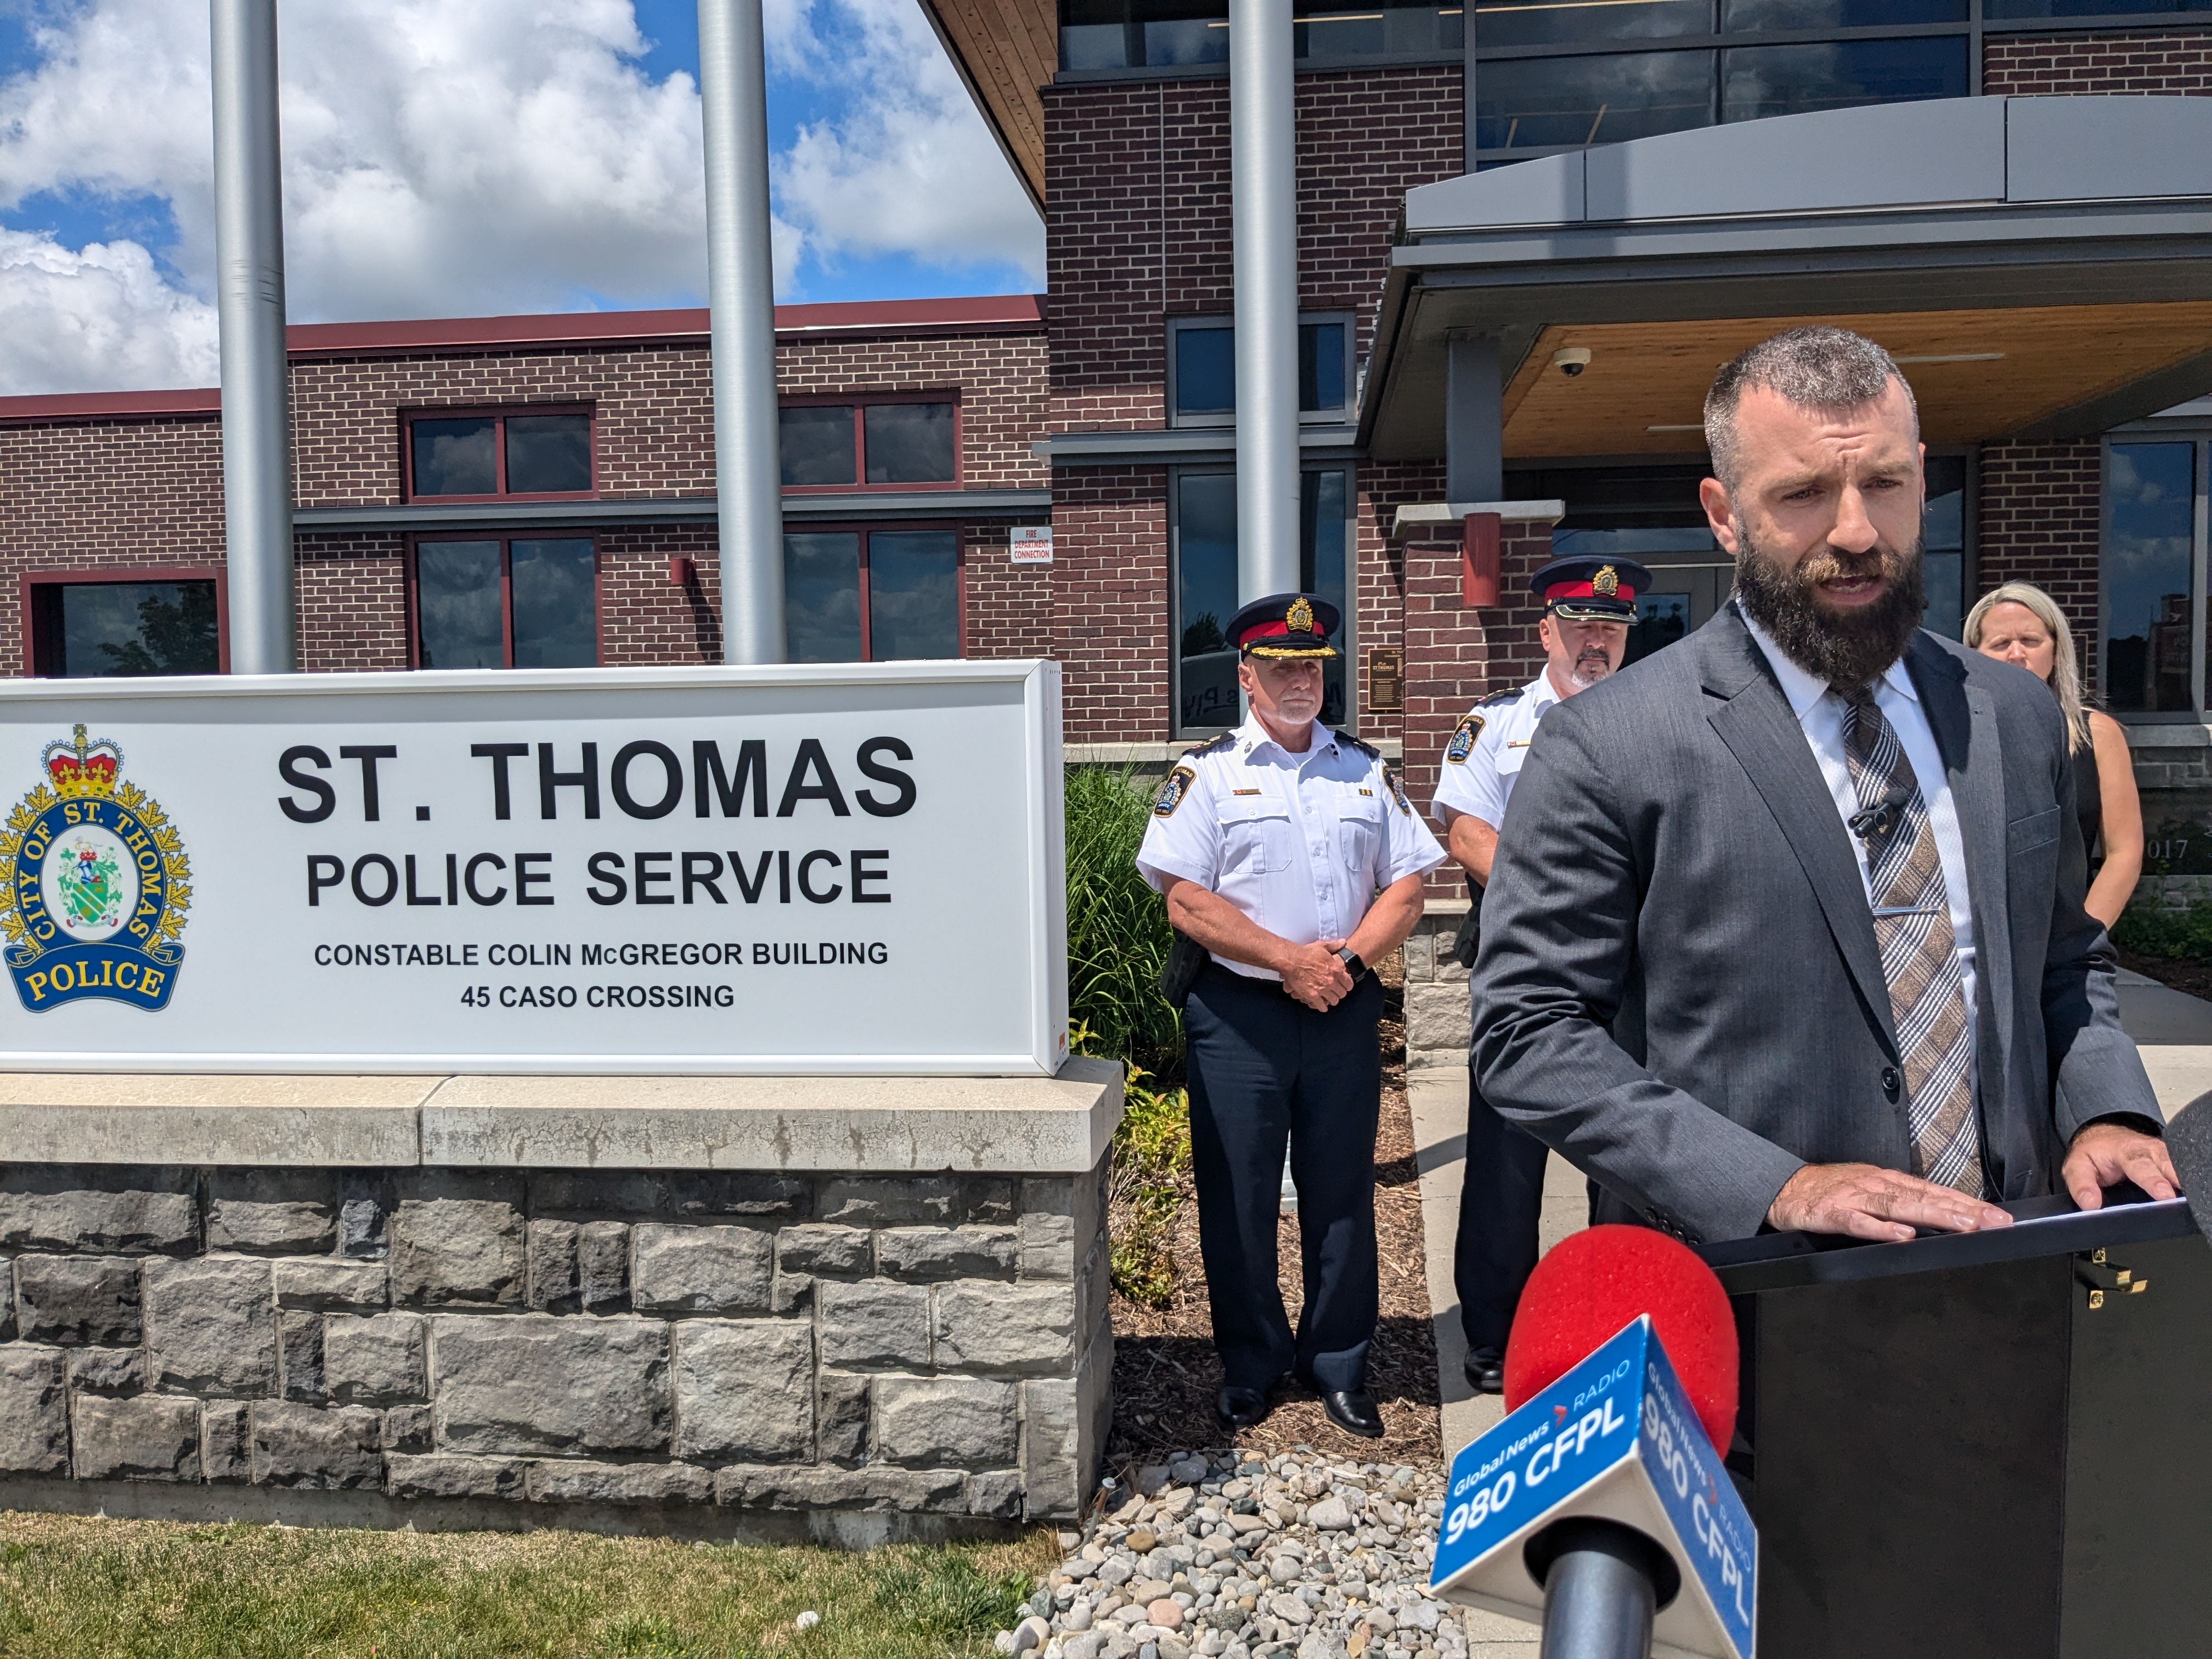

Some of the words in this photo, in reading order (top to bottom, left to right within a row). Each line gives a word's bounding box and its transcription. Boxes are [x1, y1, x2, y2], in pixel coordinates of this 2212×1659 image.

[1014, 550, 1049, 558] CONNECTION
[1015, 540, 1049, 549] DEPARTMENT
[1026, 529, 1037, 538] FIRE
[278, 744, 430, 823] ST.
[471, 736, 917, 820] THOMAS
[64, 802, 104, 825] ST.
[24, 821, 54, 861] OF
[2147, 840, 2188, 859] 017
[114, 813, 161, 939] THOMAS
[307, 853, 555, 907] POLICE
[586, 849, 891, 906] SERVICE
[20, 871, 55, 940] CITY
[314, 944, 479, 966] CONSTABLE
[488, 944, 571, 966] COLIN
[582, 943, 743, 966] McGREGOR
[753, 942, 888, 965] BUILDING
[25, 960, 166, 1002] POLICE
[461, 986, 490, 1007] 45
[499, 986, 577, 1007] CASO
[586, 985, 734, 1007] CROSSING
[1454, 1449, 1505, 1497] Global
[1506, 1421, 1550, 1460] News
[1573, 1359, 1630, 1412] RADIO
[1444, 1470, 1516, 1545] 980
[1525, 1396, 1624, 1487] CFPL
[1648, 1362, 1680, 1427] Global
[1680, 1429, 1707, 1486] News
[1719, 1504, 1752, 1573] RADIO
[1645, 1392, 1688, 1498] 980
[1692, 1492, 1750, 1628] CFPL
